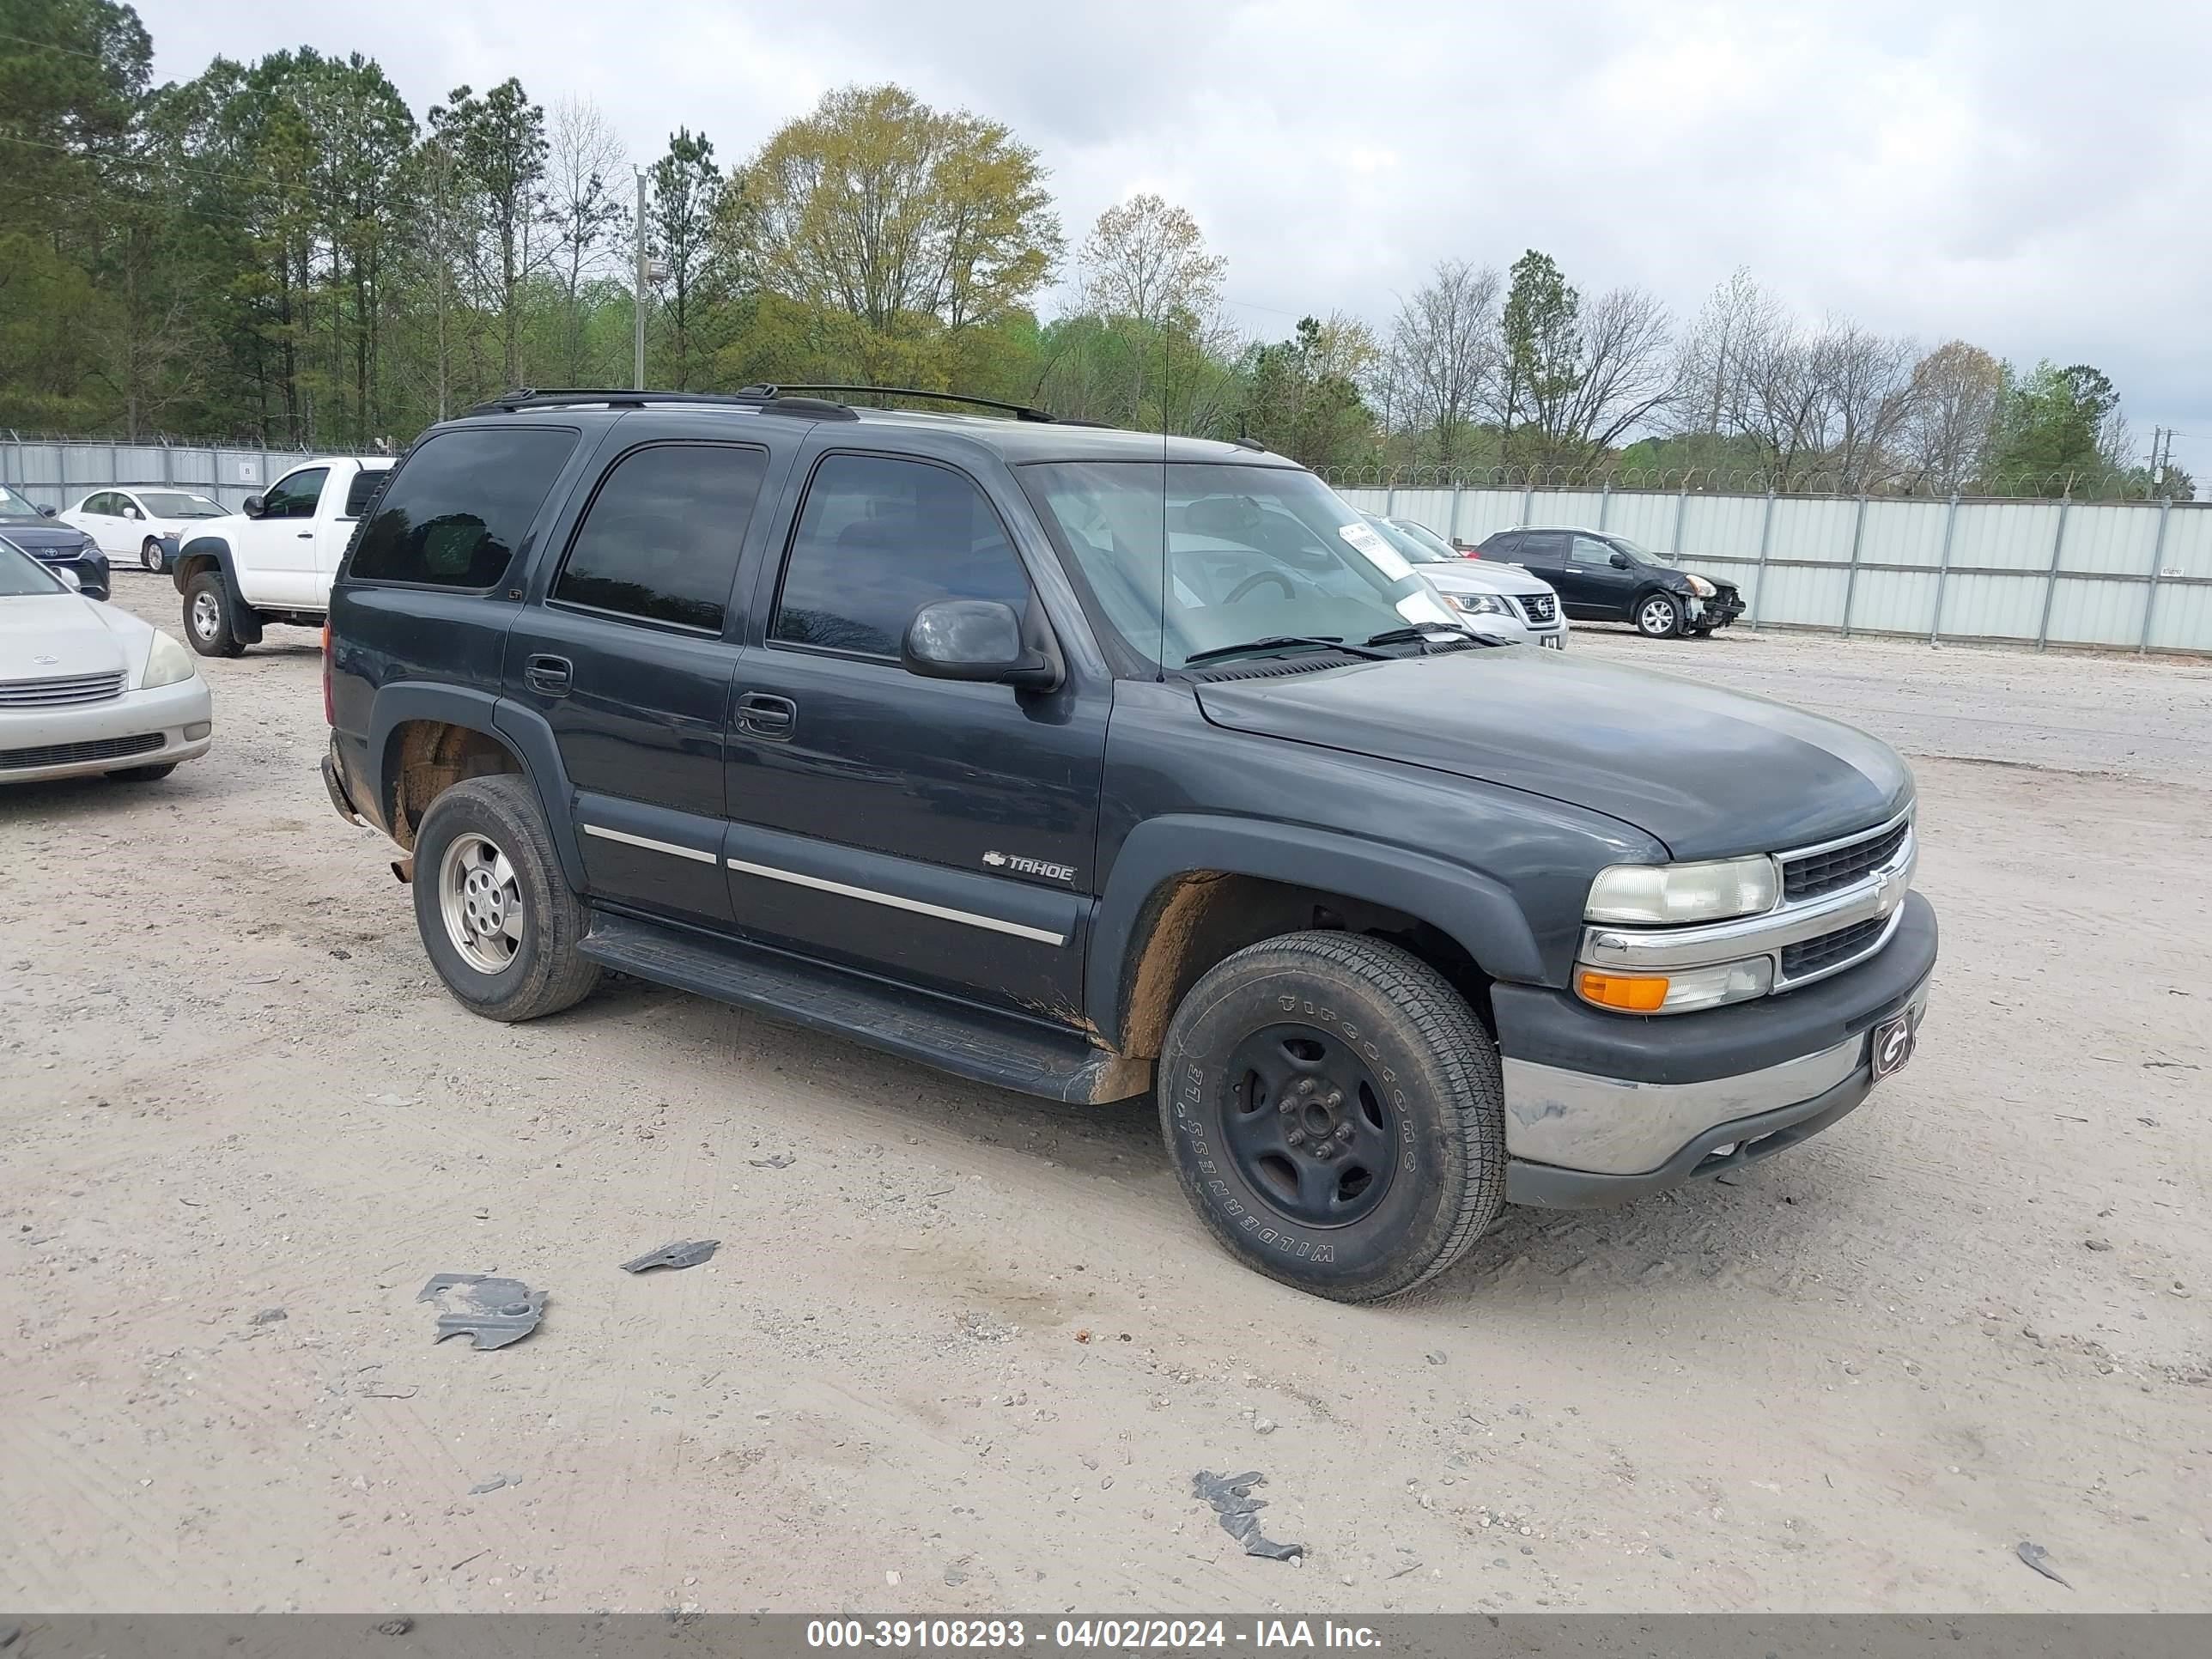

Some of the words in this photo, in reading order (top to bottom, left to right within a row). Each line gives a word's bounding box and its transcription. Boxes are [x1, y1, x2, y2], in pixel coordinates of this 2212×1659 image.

[1010, 857, 1075, 880] TAHOE
[1884, 1030, 1907, 1062] G
[1185, 1064, 1203, 1103] LE
[1188, 1120, 1334, 1262] WILDERNESS
